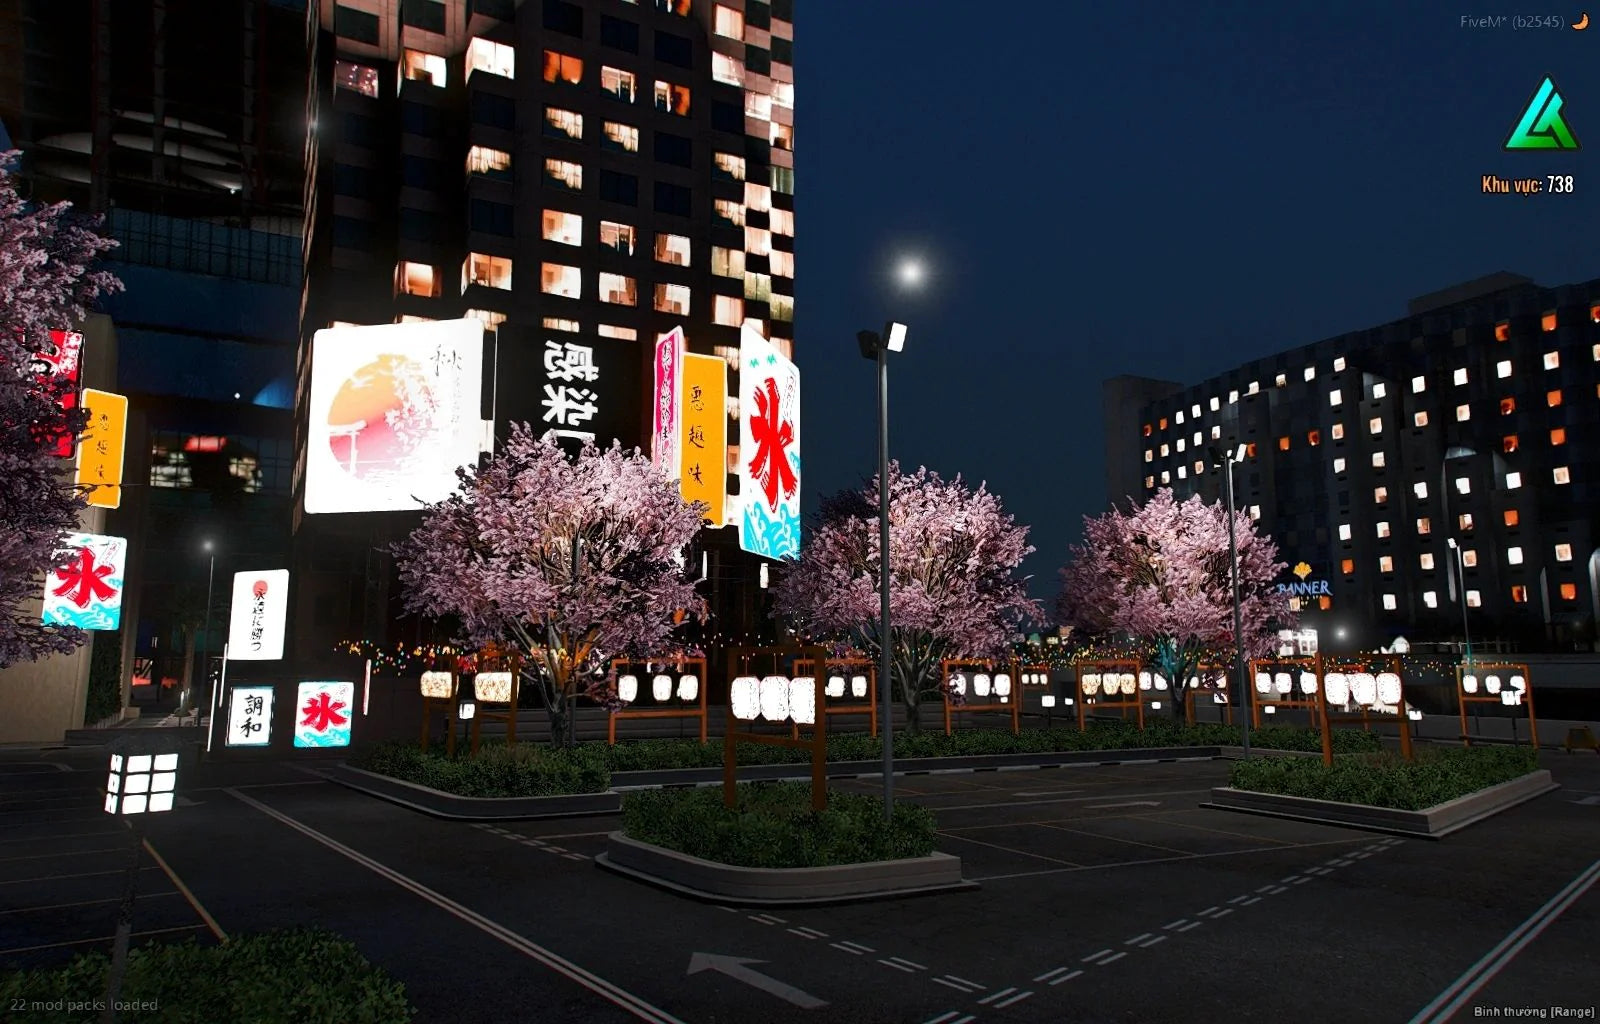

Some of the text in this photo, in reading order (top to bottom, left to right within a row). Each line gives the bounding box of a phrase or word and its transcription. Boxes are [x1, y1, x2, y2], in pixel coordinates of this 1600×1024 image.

[748, 376, 798, 514] 氷
[1276, 580, 1334, 597] BANNER
[240, 693, 264, 738] 調和
[300, 691, 348, 733] 氷
